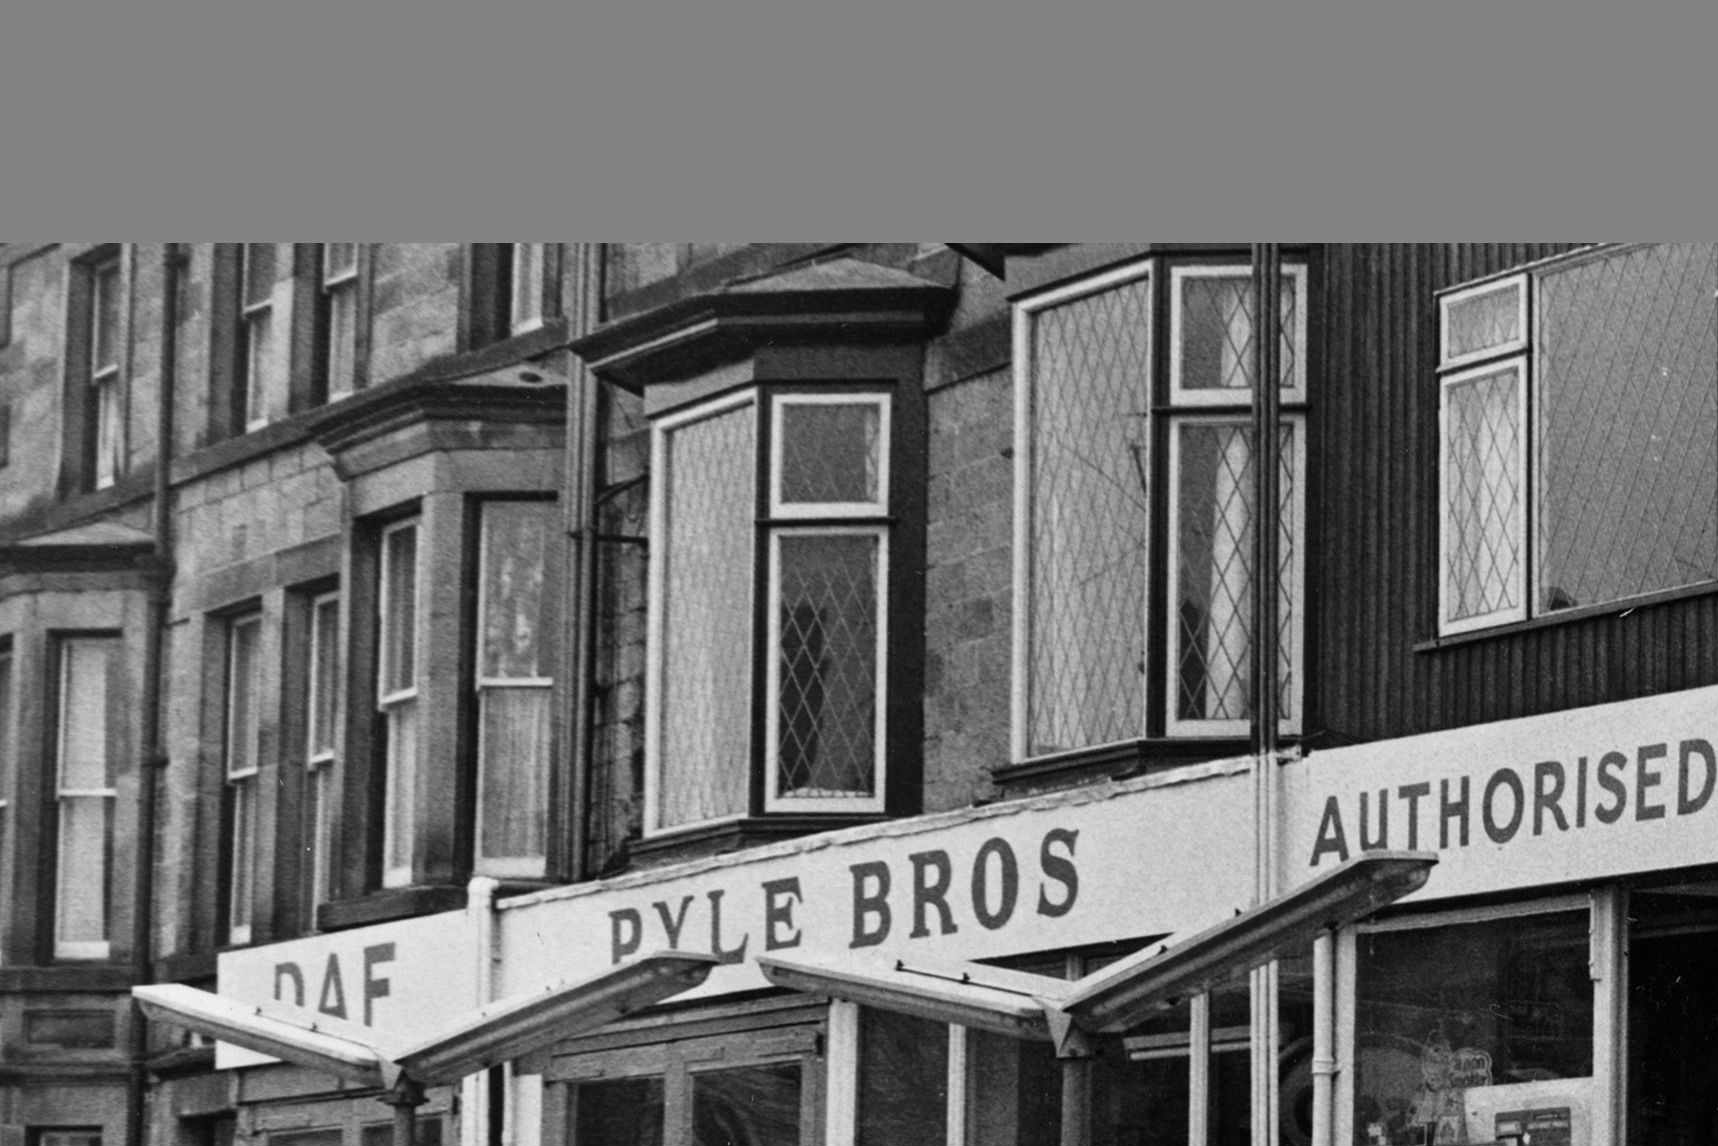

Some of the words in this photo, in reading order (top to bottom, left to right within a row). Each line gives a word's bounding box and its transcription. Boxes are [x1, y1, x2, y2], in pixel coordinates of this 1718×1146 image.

[1309, 738, 1718, 867] AUTHORISED
[608, 877, 803, 965] PYLE
[849, 828, 1080, 949] BROS
[274, 942, 396, 1027] DAF
